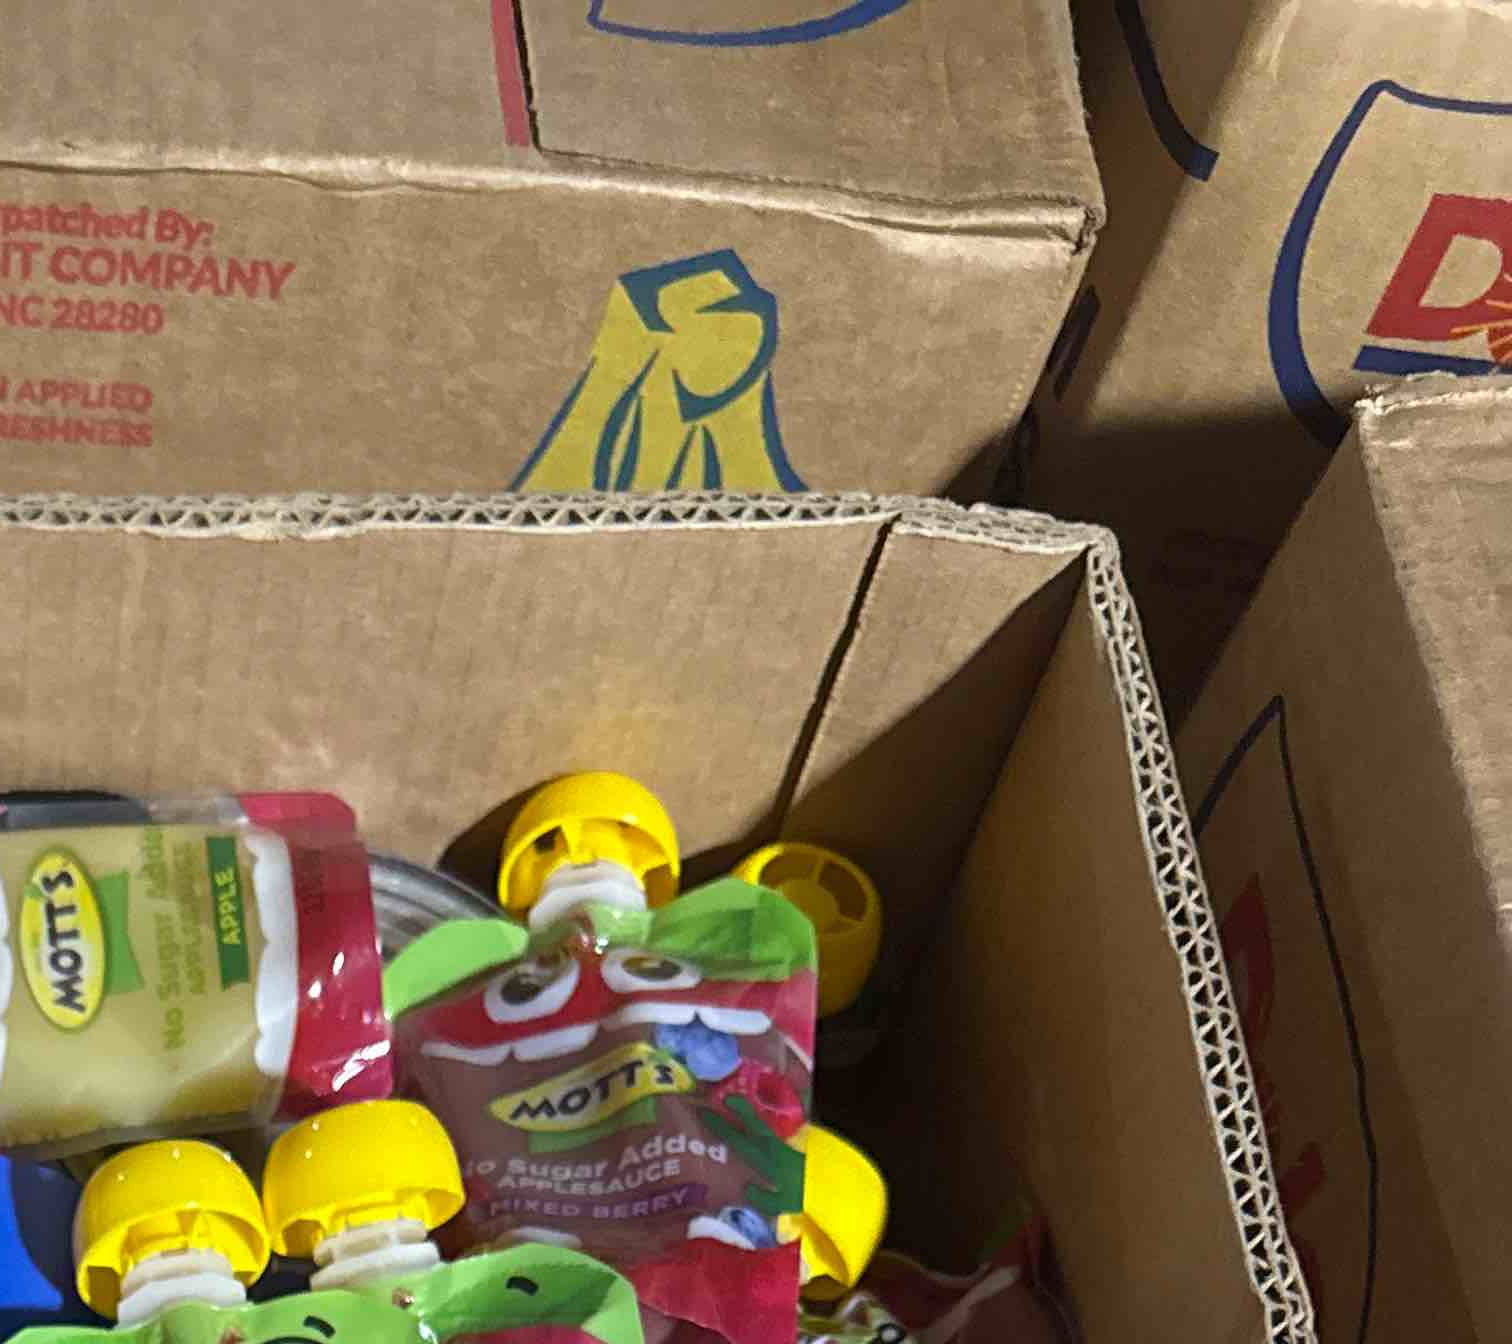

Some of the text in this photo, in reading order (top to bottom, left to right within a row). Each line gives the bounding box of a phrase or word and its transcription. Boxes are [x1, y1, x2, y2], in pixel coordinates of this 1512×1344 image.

[153, 207, 215, 252] By:
[49, 243, 296, 300] COMPANY
[49, 299, 166, 336] 28280
[213, 866, 241, 946] APPLE
[497, 1157, 684, 1196] APPLESAUCE
[507, 1149, 608, 1185] Sugar
[617, 1133, 730, 1167] Added
[591, 1187, 692, 1221] BERRY
